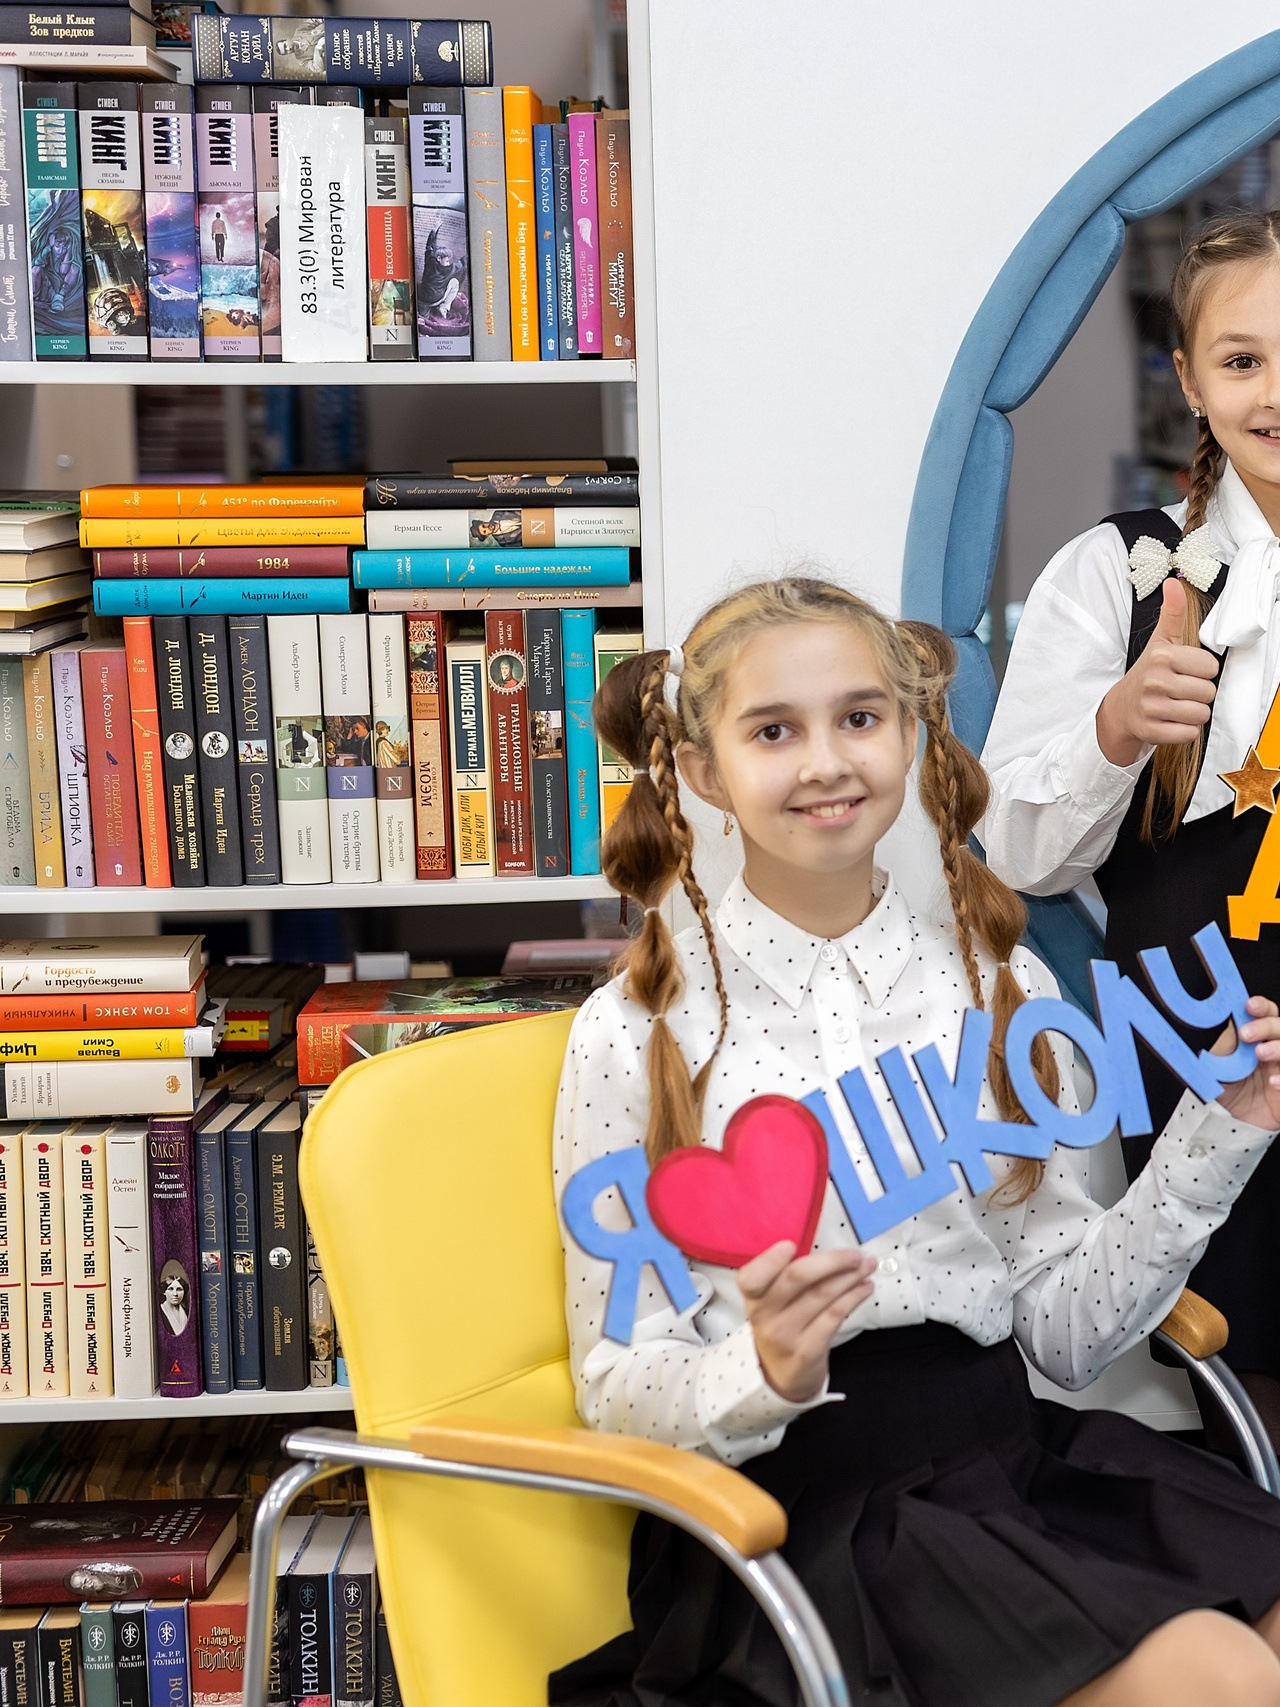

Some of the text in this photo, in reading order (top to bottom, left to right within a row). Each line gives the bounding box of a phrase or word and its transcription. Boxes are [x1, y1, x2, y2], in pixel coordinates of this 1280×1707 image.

[29, 14, 95, 24] Белый Клык
[30, 25, 94, 38] Зов предков
[230, 31, 239, 62] АРТУР
[241, 31, 250, 64] КОНАН
[252, 34, 262, 61] ДОЙЛ
[332, 33, 341, 65] Полное
[343, 29, 353, 70] собрание
[37, 98, 58, 107] СТИВЕН
[98, 98, 118, 108] СТИВЕН
[154, 101, 175, 110] СТИВЕН
[211, 101, 231, 110] СТИВЕН
[423, 102, 446, 112] СТИВЕН
[36, 113, 67, 168] КИНГ
[91, 116, 127, 170] КИНГ
[153, 117, 182, 170] КИНГ
[208, 118, 237, 171] КИНГ
[374, 130, 395, 142] СТИВЕН
[423, 120, 452, 173] КИНГ
[377, 150, 396, 200] КИНГ
[298, 156, 318, 314] 83.3(0) Мировая
[329, 181, 345, 289] литература
[516, 222, 529, 346] Над пропастью во ржи
[608, 262, 618, 307] МИНУТ
[617, 252, 626, 317] ОДИННАДЦАТЬ
[394, 524, 442, 533] Герман Гессе
[257, 558, 289, 569] 1984
[495, 565, 591, 575] Большие надежды
[242, 591, 308, 600] Мартин Иден
[164, 640, 184, 710] Д. ЛОНДОН
[198, 633, 220, 714] Д. ЛОНДОН
[239, 636, 259, 732] Джек ЛОНДОН
[291, 641, 302, 692] Альбер Камю
[383, 635, 394, 699] Франсуа Мориак
[533, 645, 542, 678] Маркес
[541, 628, 555, 695] Габриэль Гарсиа
[31, 668, 45, 740] Пауло Коэльо
[61, 668, 75, 741] Пауло Коэльо
[100, 667, 114, 739] Пауло Коэльо
[460, 666, 478, 768] ГЕРМАН МЕЛВИЛЛ
[498, 713, 509, 783] АВАНТЮРЫ
[510, 703, 523, 792] ГРАНДИОЗНЫЕ
[66, 773, 82, 846] ШПИОНКА
[111, 774, 124, 847] ПОБЕДИТЕЛЬ
[419, 760, 431, 808] МОЭМ
[12, 800, 21, 834] ВЕДЬМА
[38, 792, 53, 844] БРИДА
[142, 751, 160, 878] Над кукушкиным гнездом
[172, 785, 186, 860] Большого дома
[184, 774, 200, 870] Маленькая хозяйка
[213, 787, 227, 854] Мартин Иден
[247, 772, 266, 864] Сердца трех
[352, 810, 363, 871] Острие бритвы
[460, 794, 472, 860] МОБИ ДИК, ИЛИ
[45, 966, 96, 977] Гордость
[3, 1006, 171, 1020] ТОМ ХЭНКС УНИКАЛЬНЫЙ
[77, 1048, 121, 1057] Вацлав
[151, 1141, 186, 1159] ОЛКОТТ
[562, 921, 1261, 1346] Я ШКОЛУ
[37, 1158, 52, 1277] 1984. СКОТНЫЙ ДВОР
[232, 1156, 249, 1243] Джейн ОСТЕН
[271, 1154, 285, 1229] Э.М. РЕМАРК
[80, 1159, 96, 1279] 1984. СКОТНЫЙ ДВОР
[123, 1277, 133, 1358] Мэнсфилд-парк
[245, 1281, 254, 1319] Гордость
[207, 1282, 221, 1375] Хорошие жены
[273, 1306, 283, 1356] обетованная
[283, 1317, 293, 1344] Земля
[12, 1641, 27, 1705] ВЛАСТЕЛИН
[59, 1639, 73, 1703] ВЛАСТЕЛИН
[152, 1658, 184, 1666] ТОЛКИН
[300, 1609, 319, 1694] ТОЛКИН
[345, 1609, 363, 1694] ТОЛКИН
